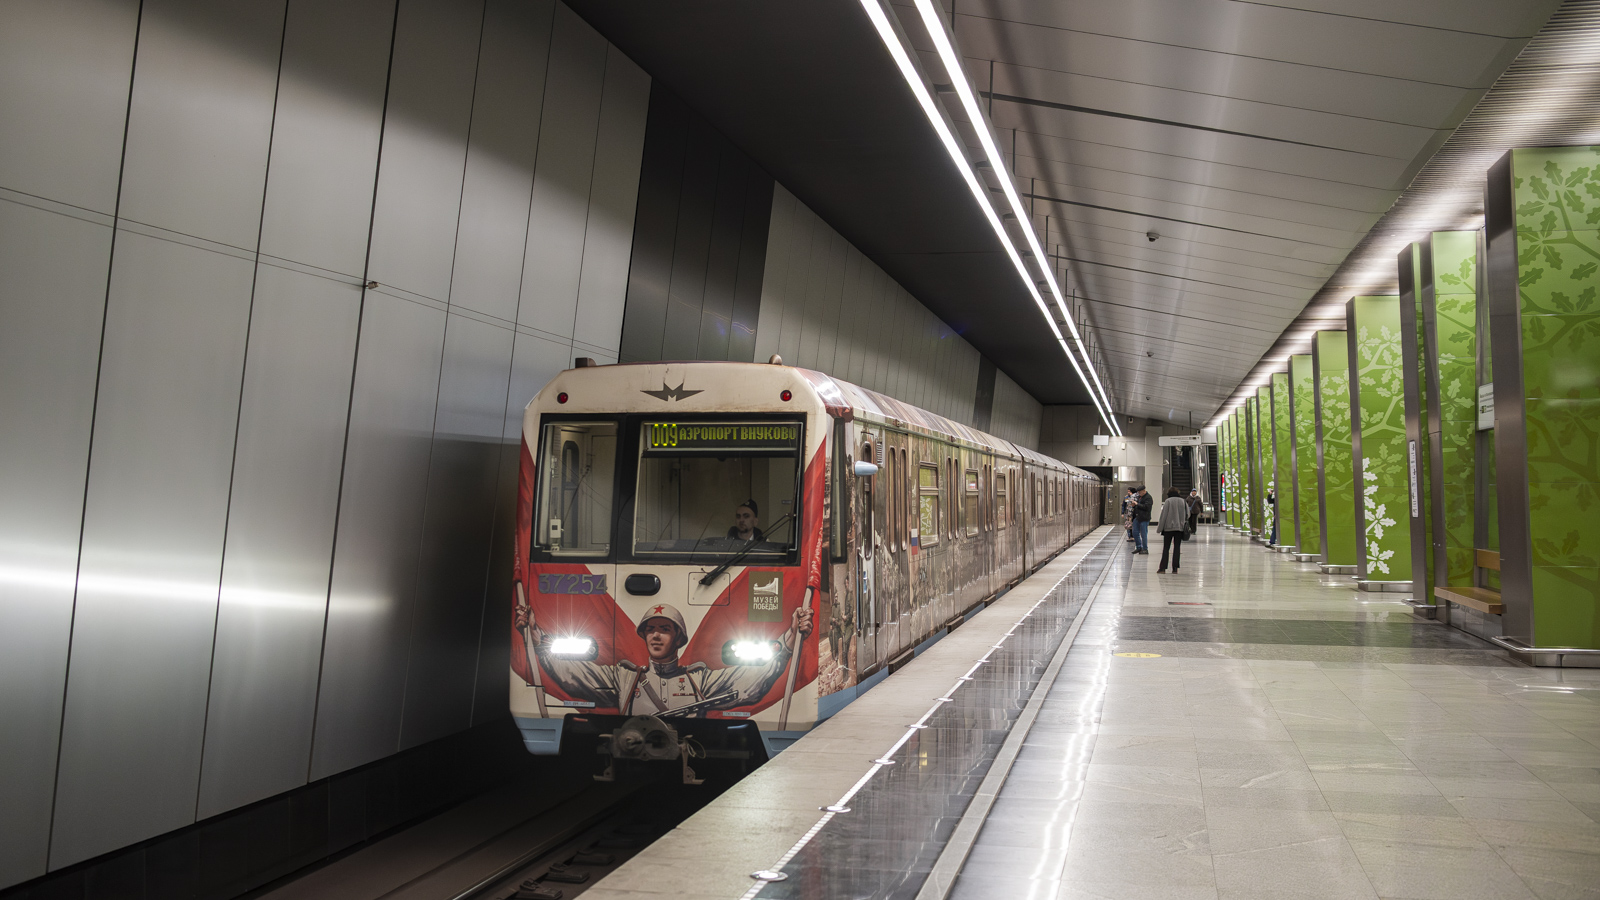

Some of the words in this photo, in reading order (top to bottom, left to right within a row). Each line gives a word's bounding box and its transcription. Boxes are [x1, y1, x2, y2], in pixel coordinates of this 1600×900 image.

[651, 424, 678, 446] 009
[679, 426, 739, 440] АЭРОПОРТ
[741, 427, 797, 440] ВНУКОВО
[538, 573, 608, 594] 37254
[752, 602, 779, 610] ПОБЕДЫ
